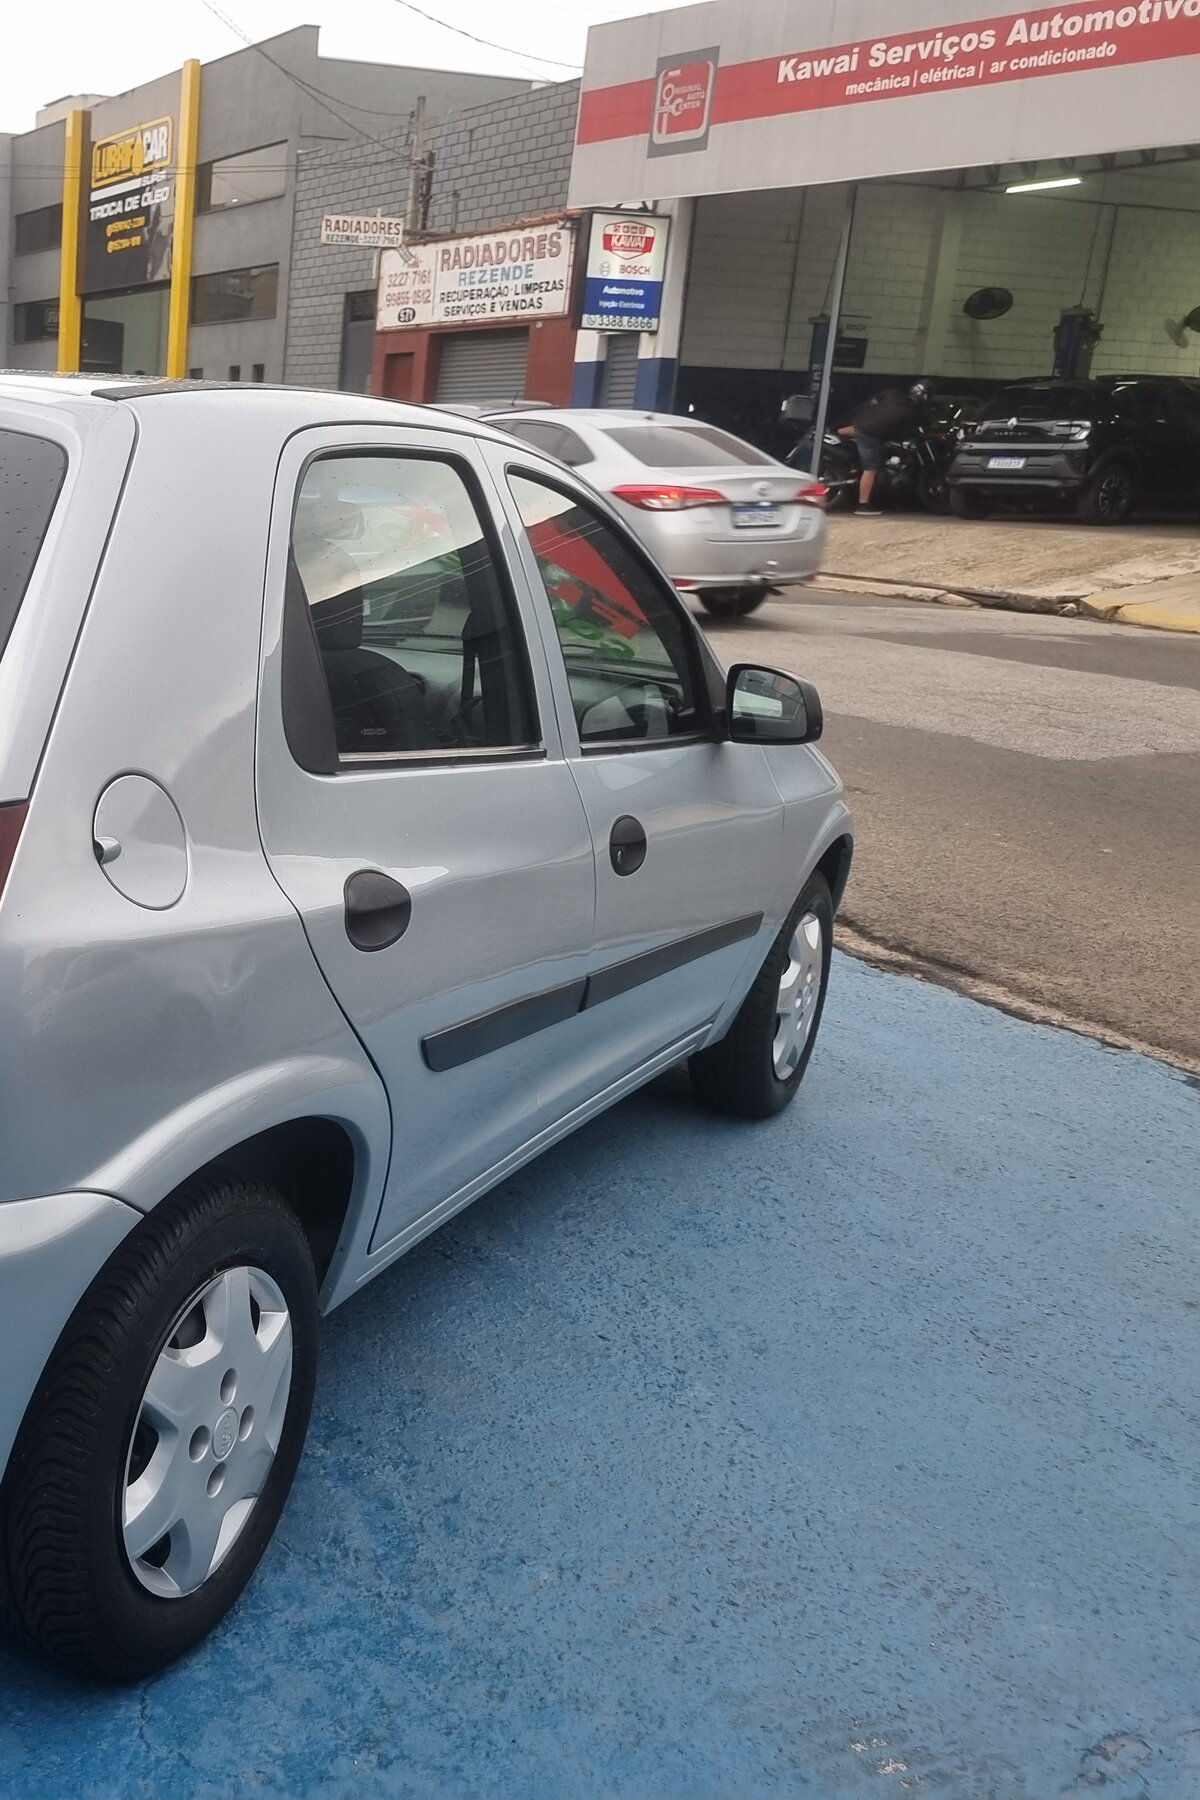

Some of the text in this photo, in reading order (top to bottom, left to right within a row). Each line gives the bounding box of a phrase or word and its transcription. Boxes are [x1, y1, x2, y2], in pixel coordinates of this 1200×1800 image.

[777, 47, 860, 83] Kawai
[868, 29, 996, 63] Serviços
[845, 41, 1117, 96] mecânica elétrica ar condicionado
[90, 200, 123, 221] TROCA
[124, 195, 141, 212] DE
[325, 219, 401, 236] RADIADORES
[440, 232, 562, 272] RADIADORES
[611, 235, 646, 248] KAWAI
[458, 263, 534, 287] REZENDE
[619, 264, 652, 275] BOSCH
[514, 279, 565, 296] LIMPEZAS
[444, 297, 543, 317] SERVIÇOS E VENDAS
